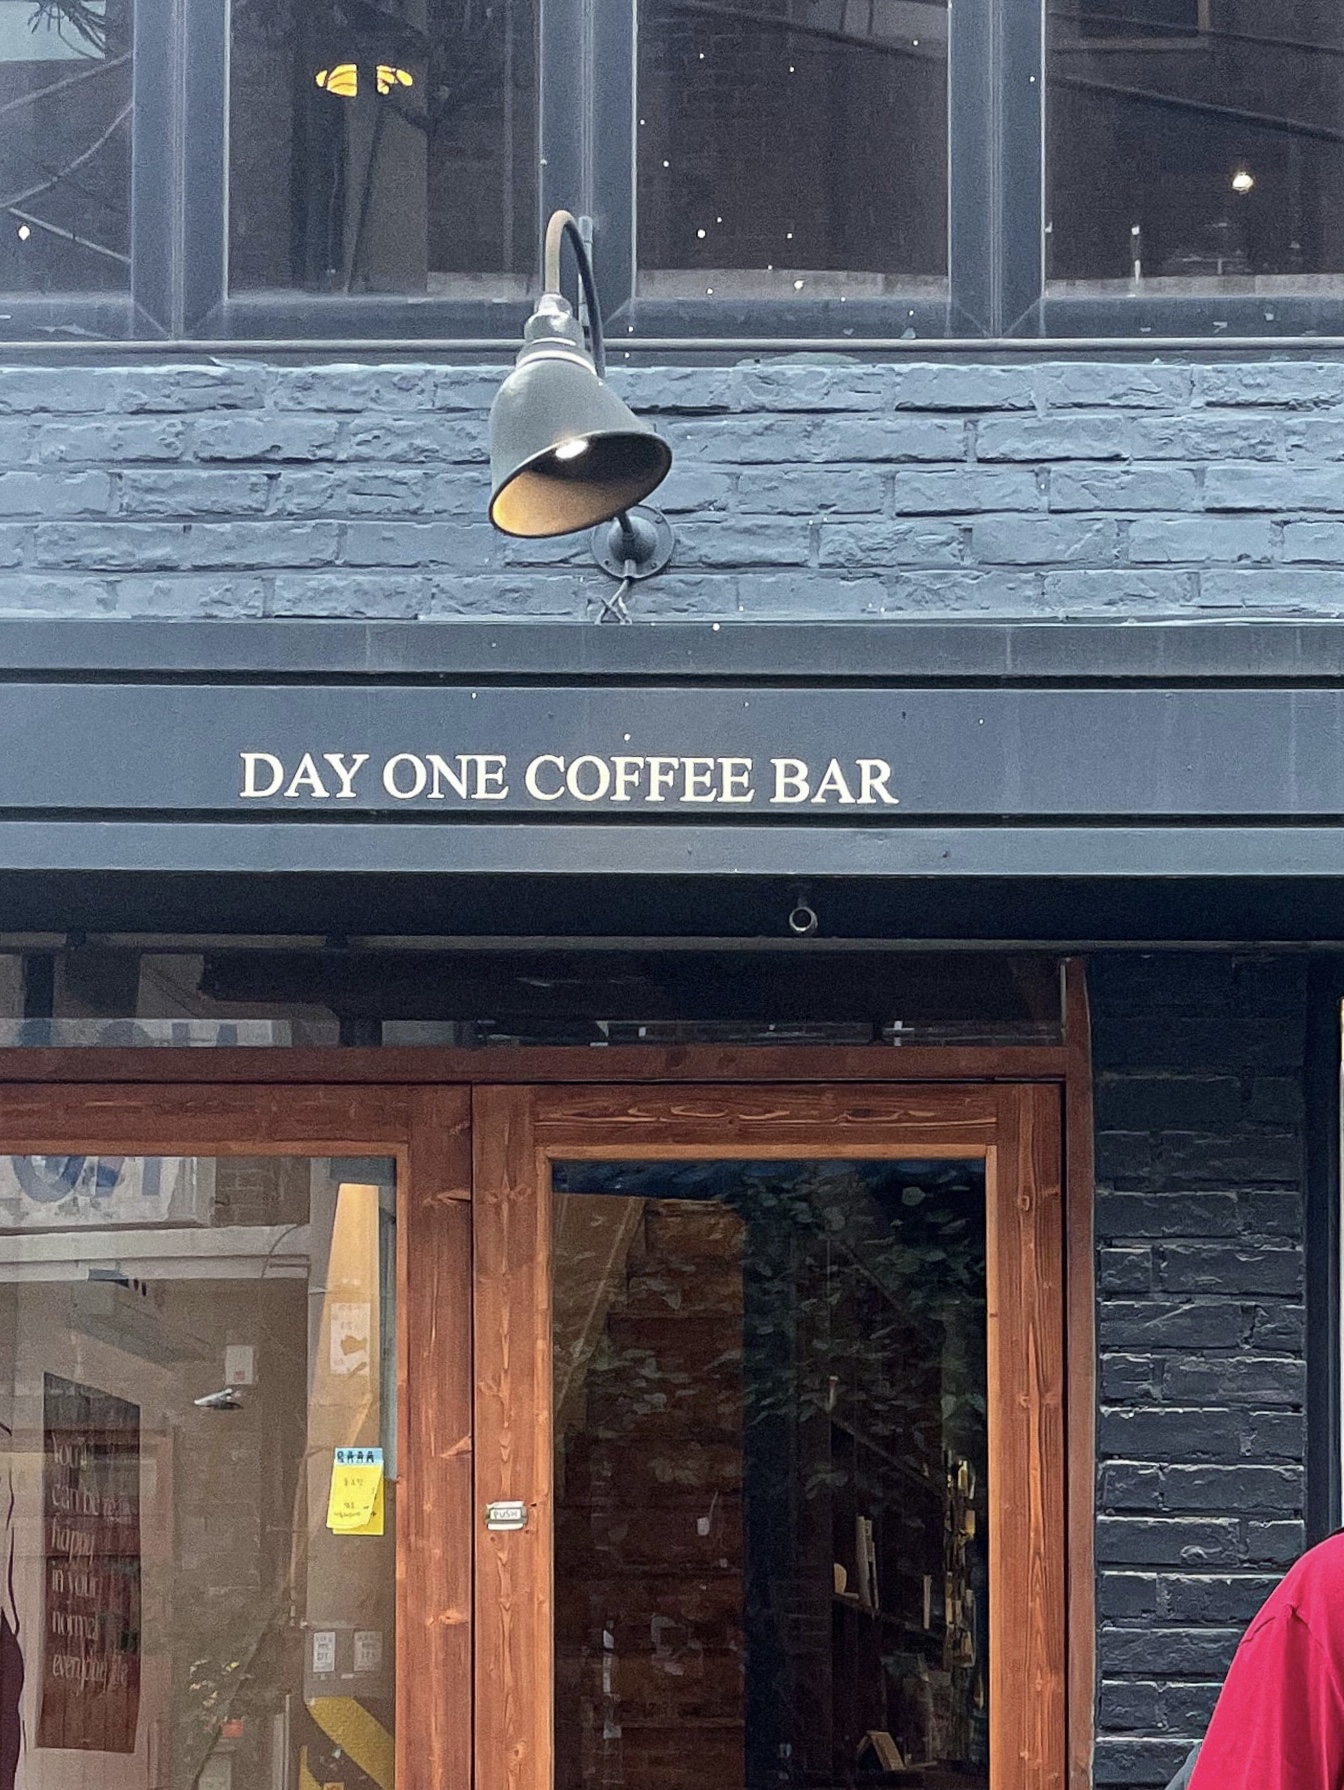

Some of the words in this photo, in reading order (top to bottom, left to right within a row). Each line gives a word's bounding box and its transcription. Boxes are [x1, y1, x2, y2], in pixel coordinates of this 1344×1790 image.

[239, 752, 370, 798] DAY
[383, 753, 509, 800] ONE
[525, 754, 755, 803] COFFEE
[769, 758, 900, 804] BAR
[493, 1510, 518, 1520] PUSH
